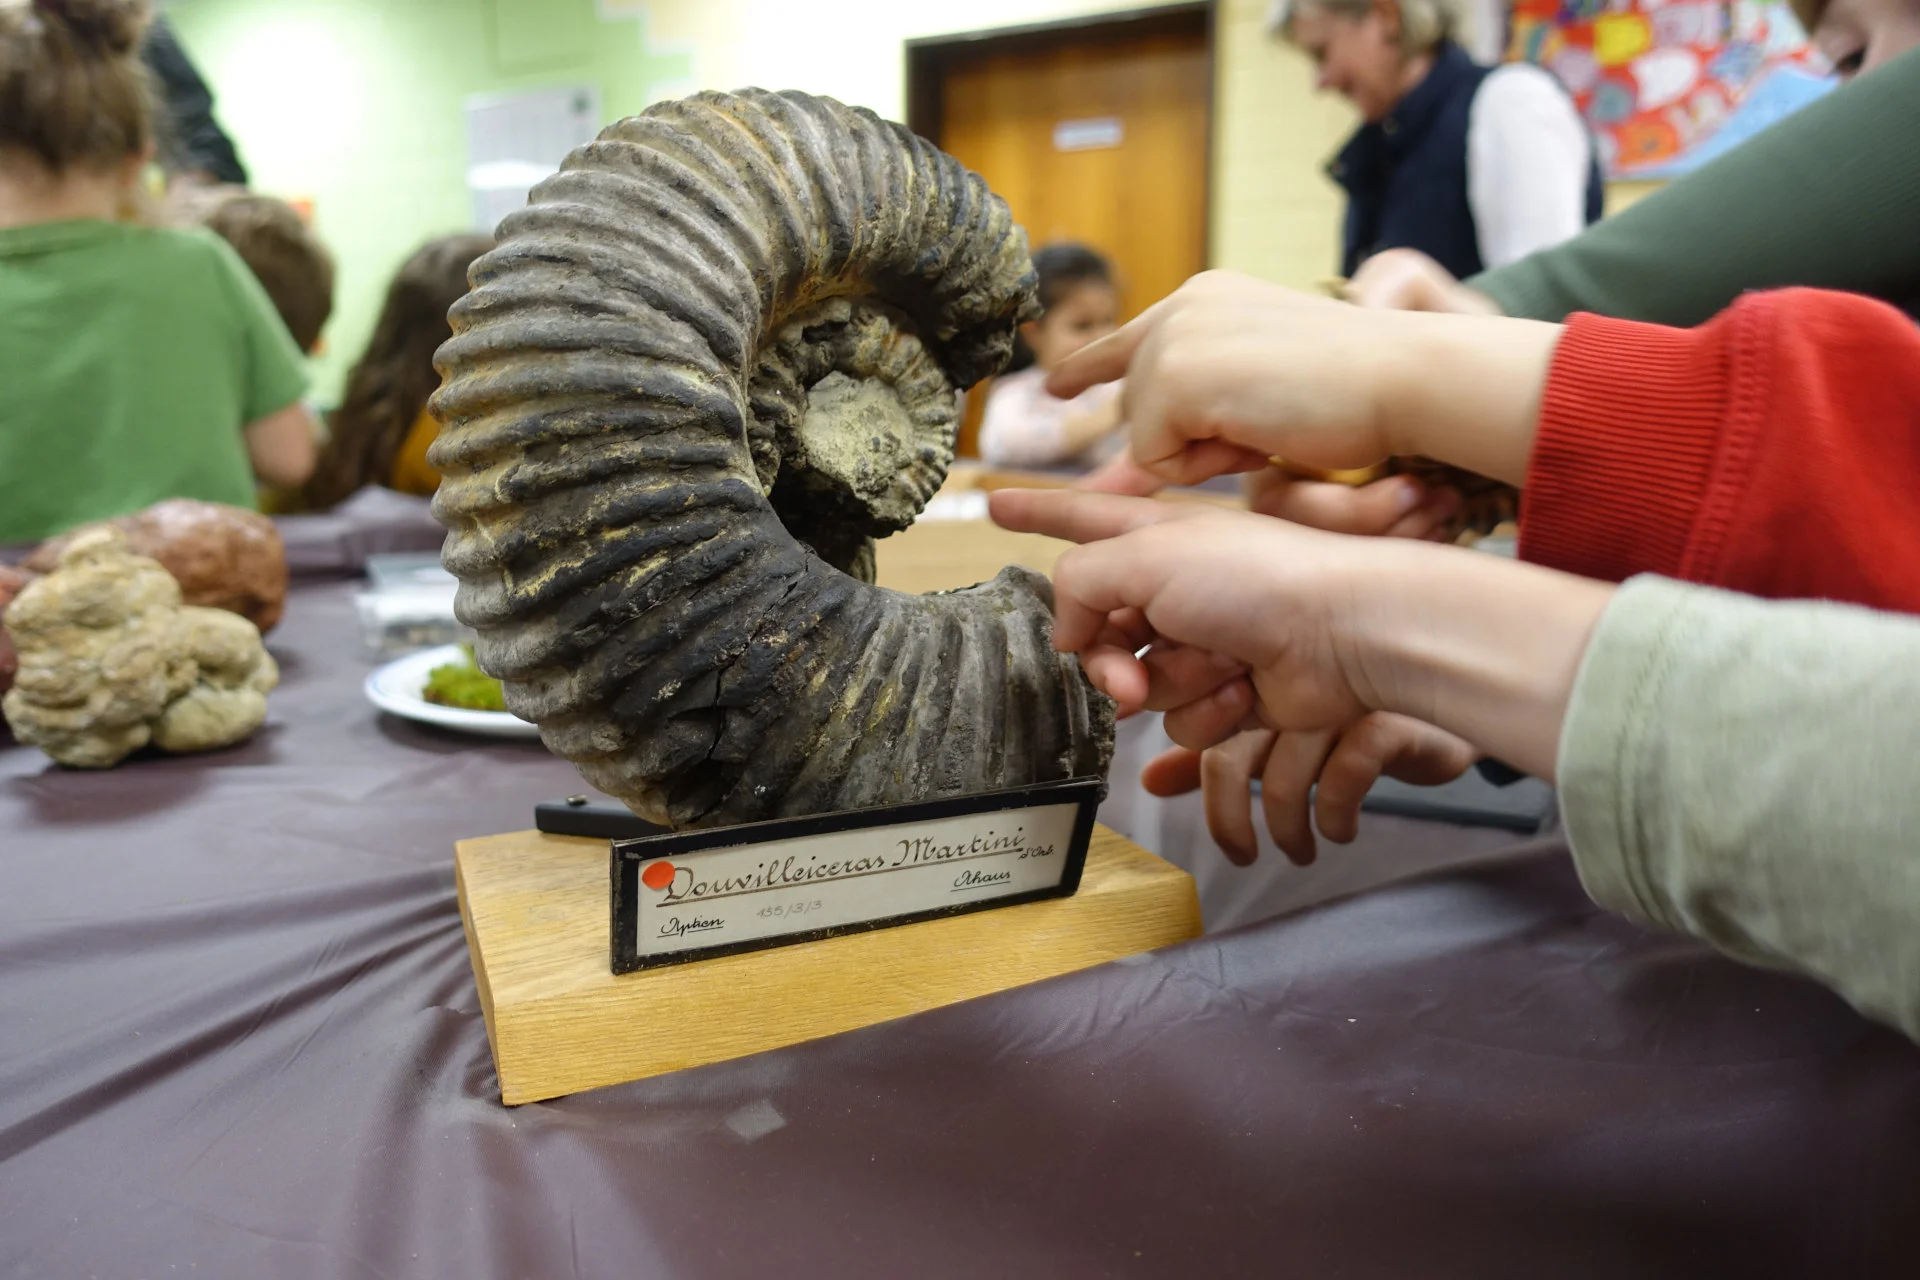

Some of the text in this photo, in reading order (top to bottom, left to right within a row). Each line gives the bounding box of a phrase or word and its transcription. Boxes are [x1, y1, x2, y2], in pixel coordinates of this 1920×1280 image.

[664, 855, 884, 901] Douvilleiceras
[892, 827, 1025, 867] Martini
[953, 869, 1011, 888] Ahaus
[660, 915, 725, 937] Aptien
